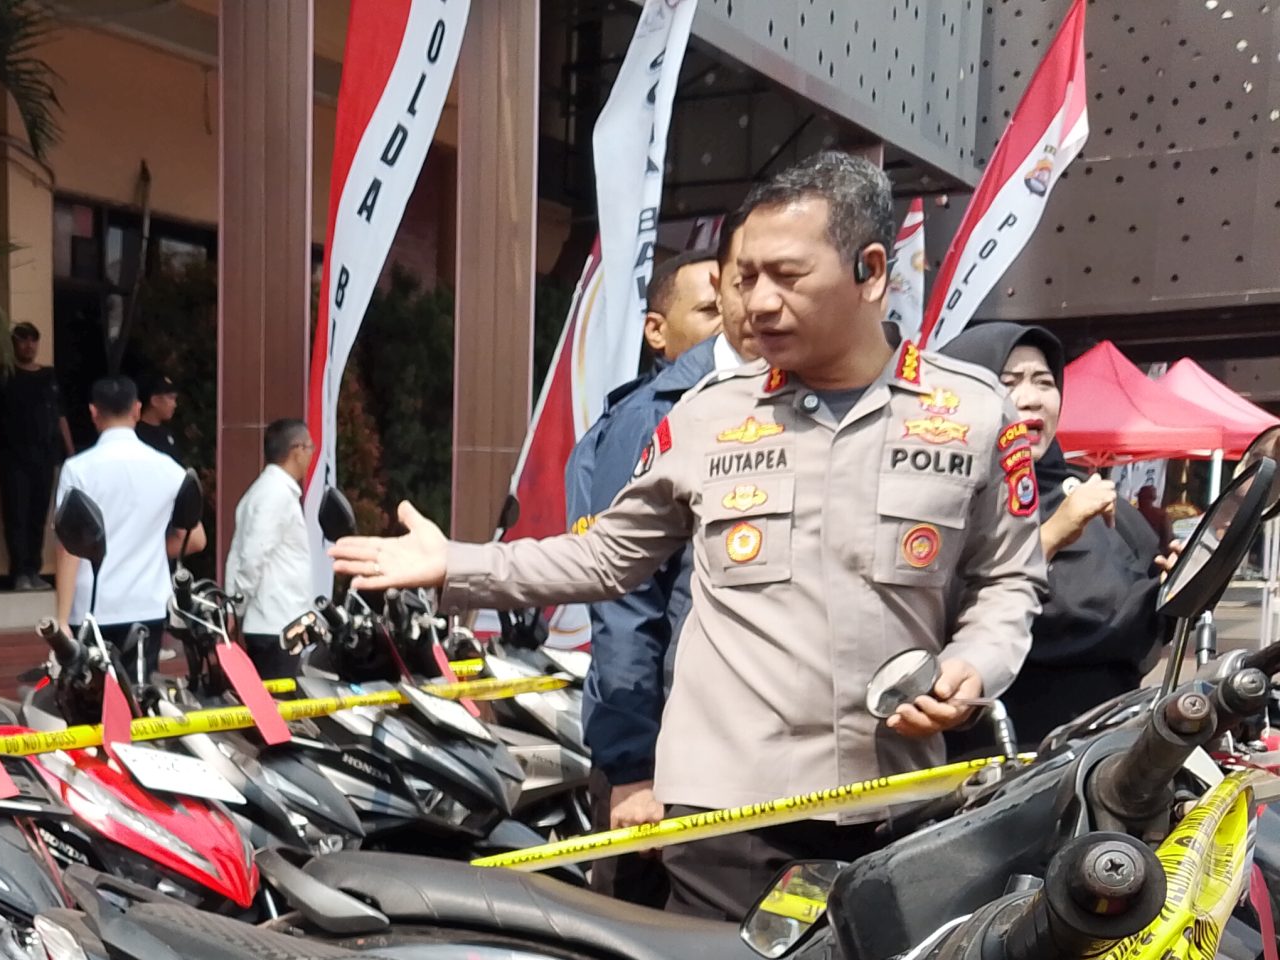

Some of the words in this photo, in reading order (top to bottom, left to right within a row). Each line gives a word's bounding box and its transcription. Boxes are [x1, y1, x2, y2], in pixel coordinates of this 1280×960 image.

[357, 0, 447, 224] OLDA
[708, 448, 788, 478] HUTAPEA
[890, 448, 973, 477] POLRI
[5, 737, 19, 753] DO
[22, 735, 42, 750] NOT
[45, 730, 78, 747] CROSS
[342, 753, 391, 785] HONDA
[40, 827, 89, 866] HONDA
